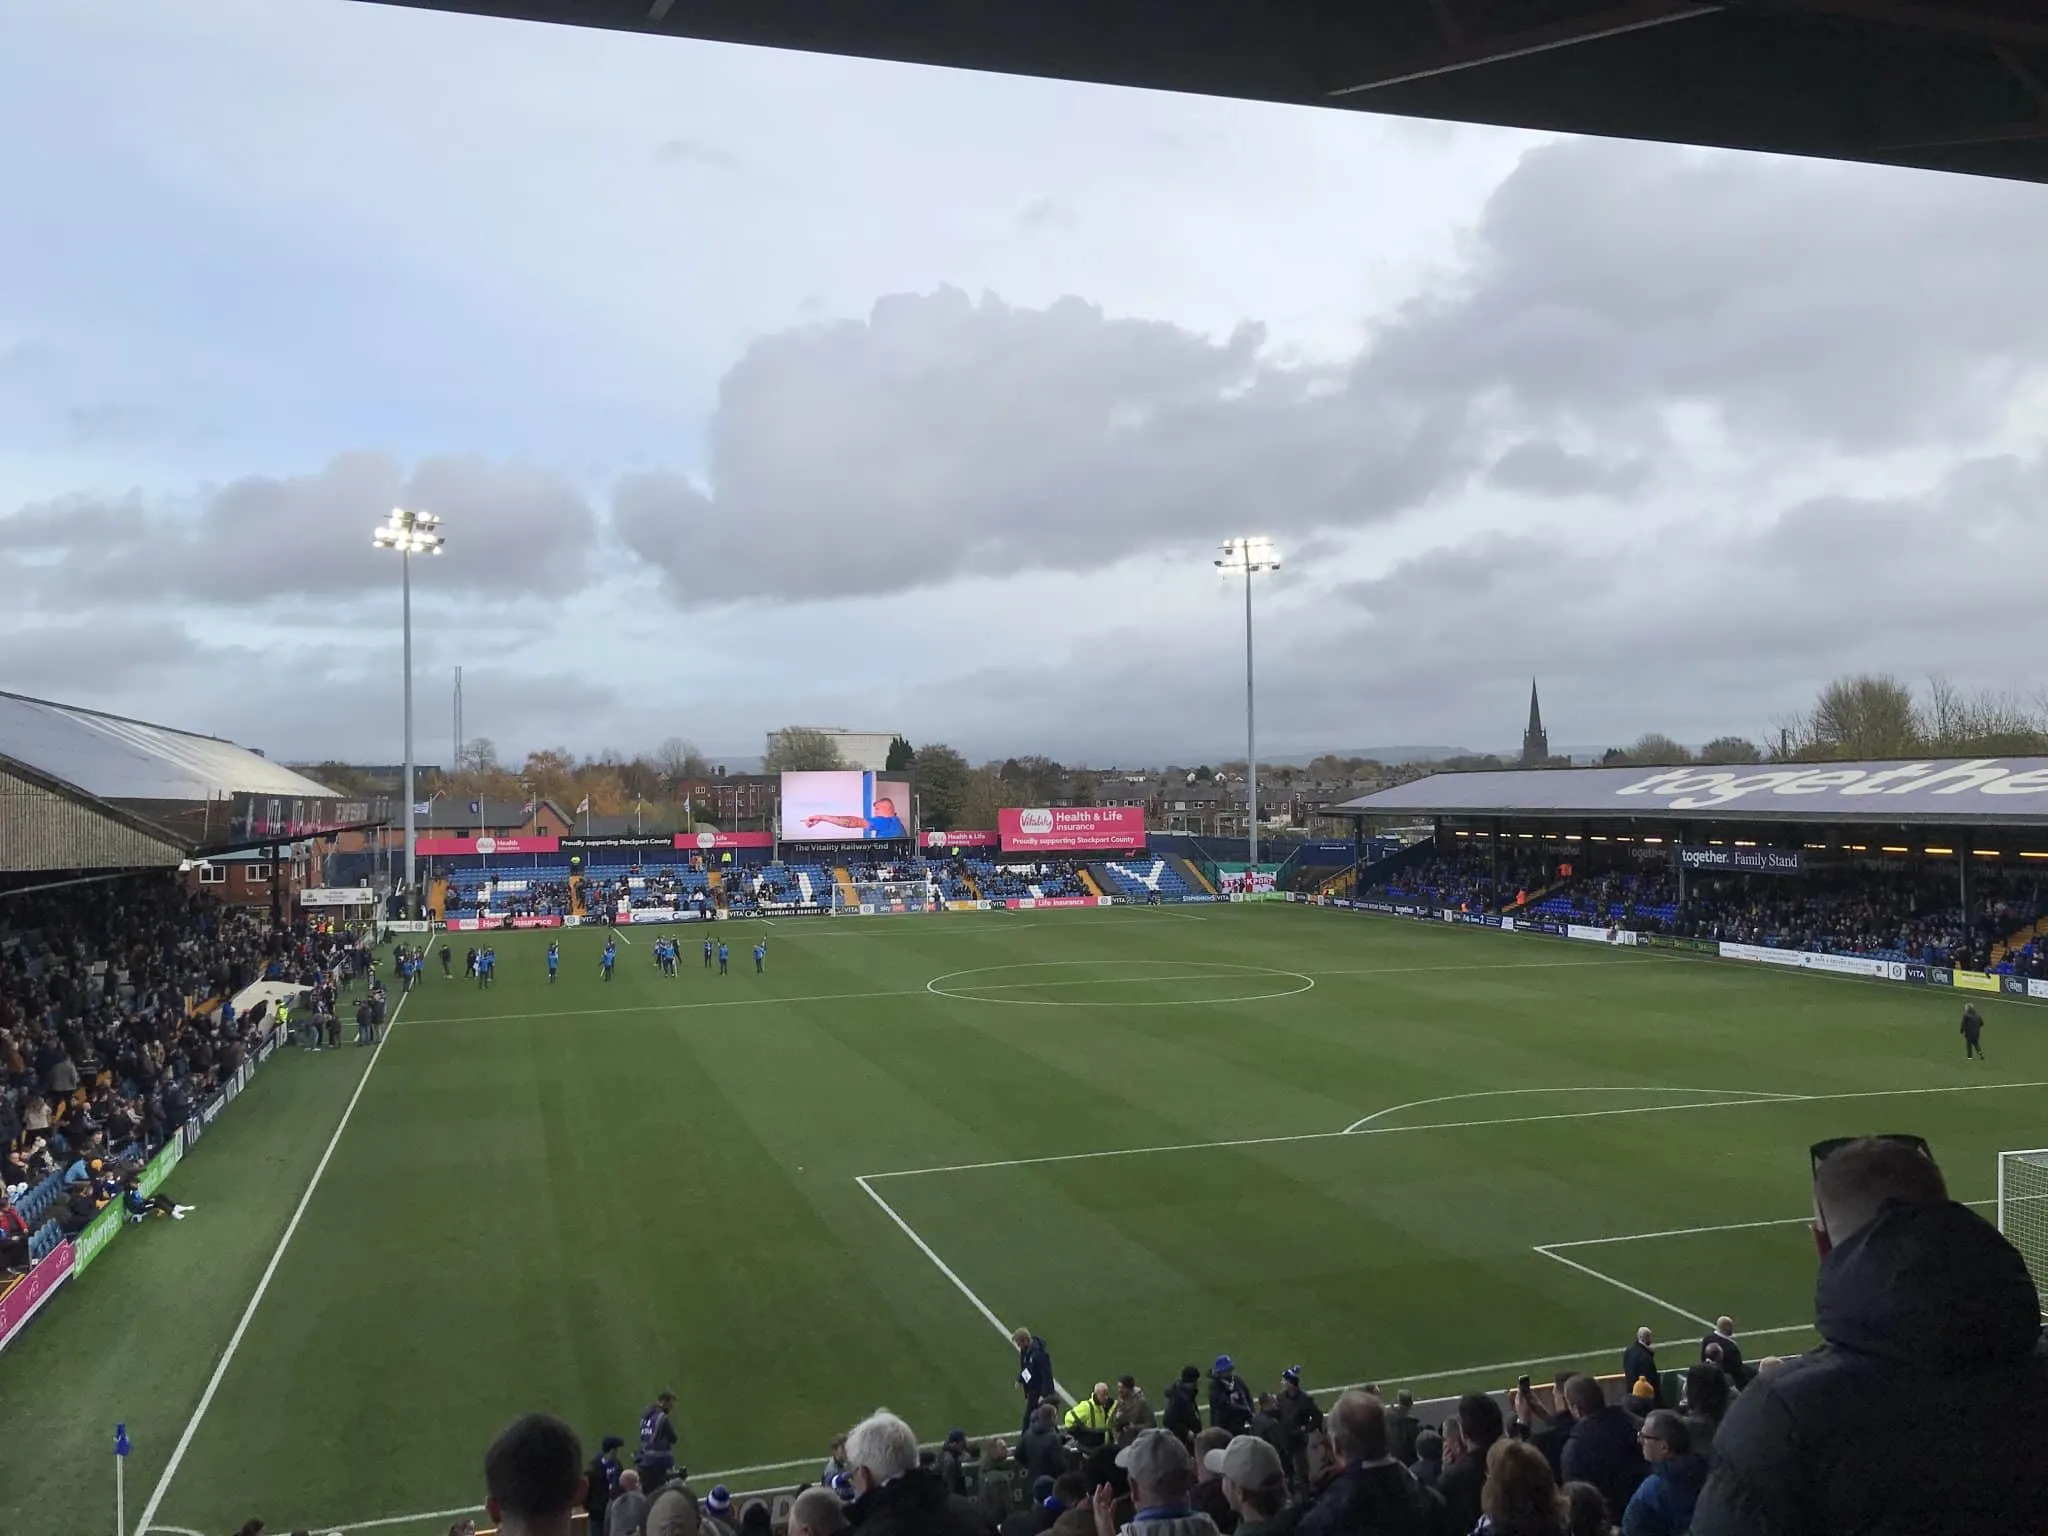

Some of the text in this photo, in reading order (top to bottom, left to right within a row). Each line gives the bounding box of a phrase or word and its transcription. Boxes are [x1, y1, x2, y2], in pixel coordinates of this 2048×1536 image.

[1056, 811, 1090, 822] Health
[1093, 811, 1101, 821] &
[1103, 810, 1123, 821] Life
[1056, 822, 1095, 831] insurance
[947, 832, 968, 841] Health
[974, 832, 986, 840] Life
[1012, 835, 1135, 846] Proudly supporting Stockport County
[561, 837, 671, 848] Proudly supporting Stockport County
[794, 841, 889, 853] The Vitality Railway End
[1734, 851, 1767, 870] Family
[1768, 853, 1798, 868] Stand
[765, 908, 796, 917] INSURANCE
[880, 905, 892, 913] sky
[911, 904, 922, 912] sky
[1907, 968, 1926, 979] VITA
